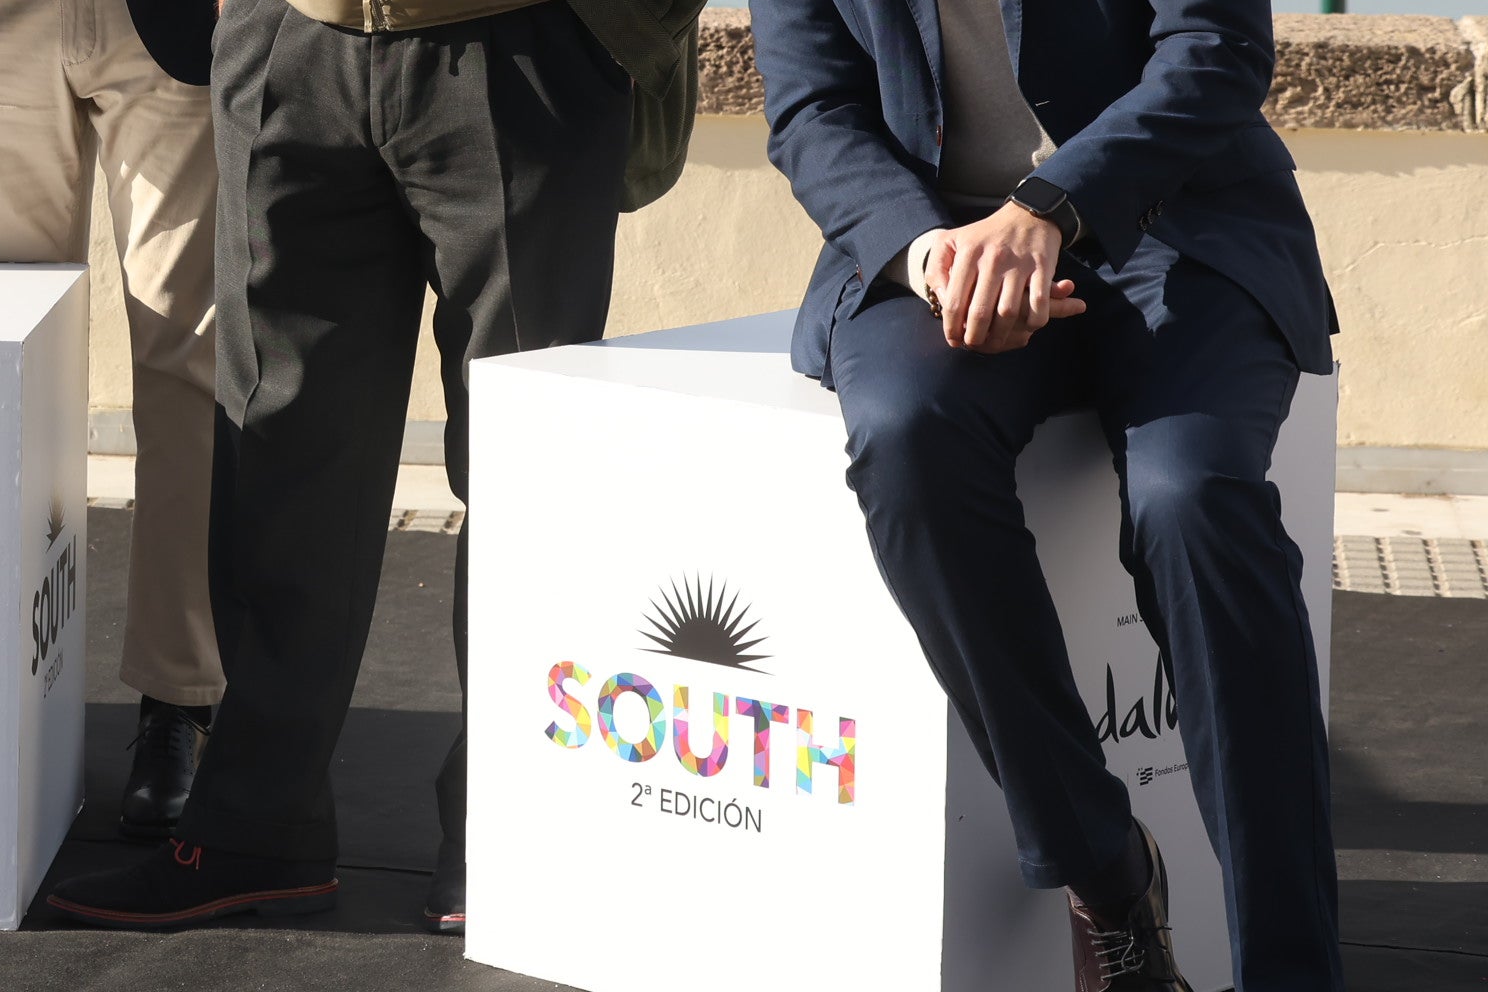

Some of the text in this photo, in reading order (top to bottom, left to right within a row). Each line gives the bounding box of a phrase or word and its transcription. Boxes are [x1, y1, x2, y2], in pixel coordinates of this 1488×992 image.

[31, 534, 77, 676] SOUTH
[1116, 613, 1138, 627] MAIN
[544, 660, 856, 807] SOUTH
[1154, 766, 1173, 777] Fondos
[631, 782, 762, 832] 2ª EDICIÓN
